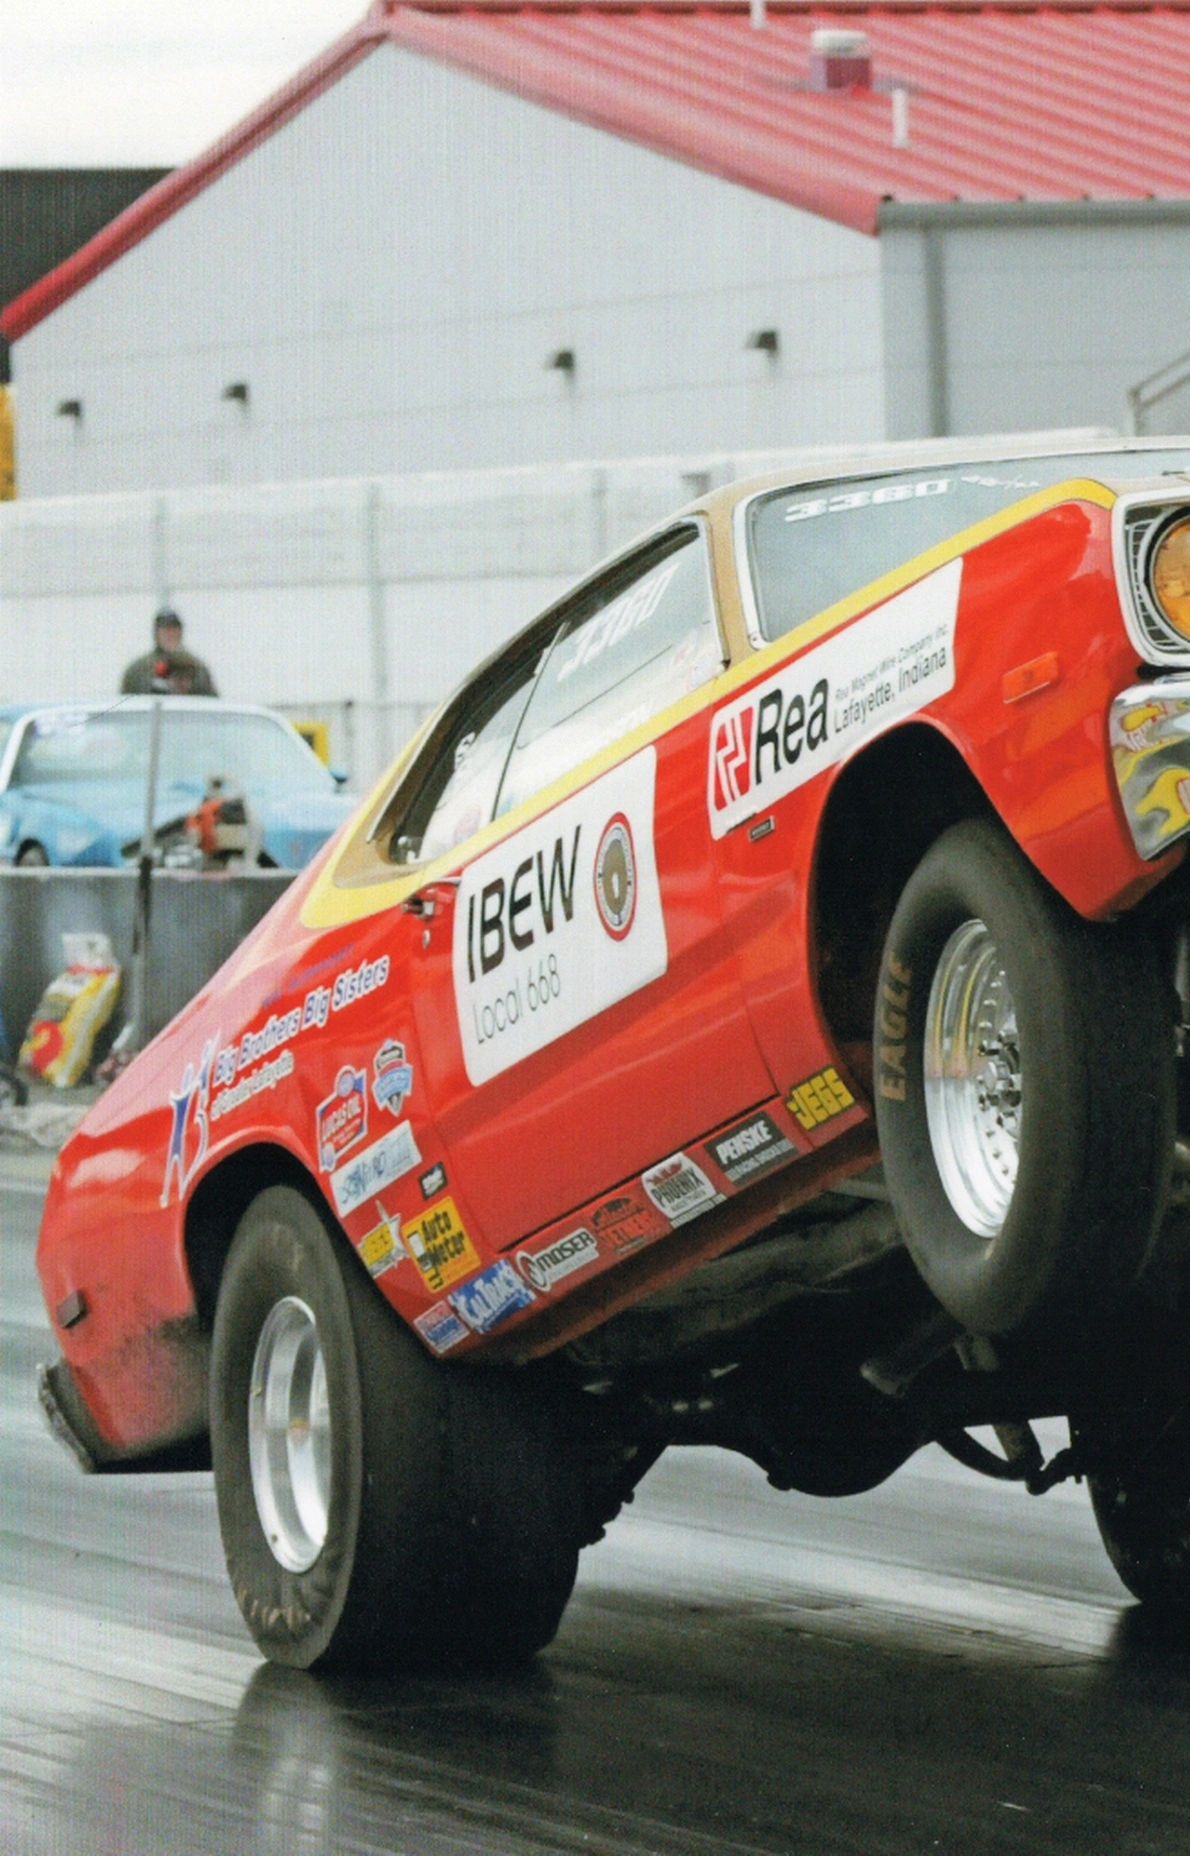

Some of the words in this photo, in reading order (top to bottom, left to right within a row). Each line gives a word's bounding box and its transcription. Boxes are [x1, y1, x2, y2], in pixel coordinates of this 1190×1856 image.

[833, 681, 895, 733] Lafayette,
[899, 646, 947, 693] Indiana
[756, 678, 829, 785] Rea
[467, 823, 582, 983] IBEW
[213, 1046, 239, 1086] Big
[238, 1009, 302, 1071] Brothers
[302, 987, 331, 1029] Big
[333, 956, 390, 1011] Sisters
[472, 975, 524, 1044] Local
[527, 953, 562, 1012] 668
[786, 1068, 856, 1130] JEGS
[716, 1120, 772, 1165] PENSKE
[650, 1167, 705, 1208] PHOENIX
[421, 1210, 453, 1242] Auto
[427, 1231, 466, 1268] Meter
[536, 1230, 596, 1273] MOSER
